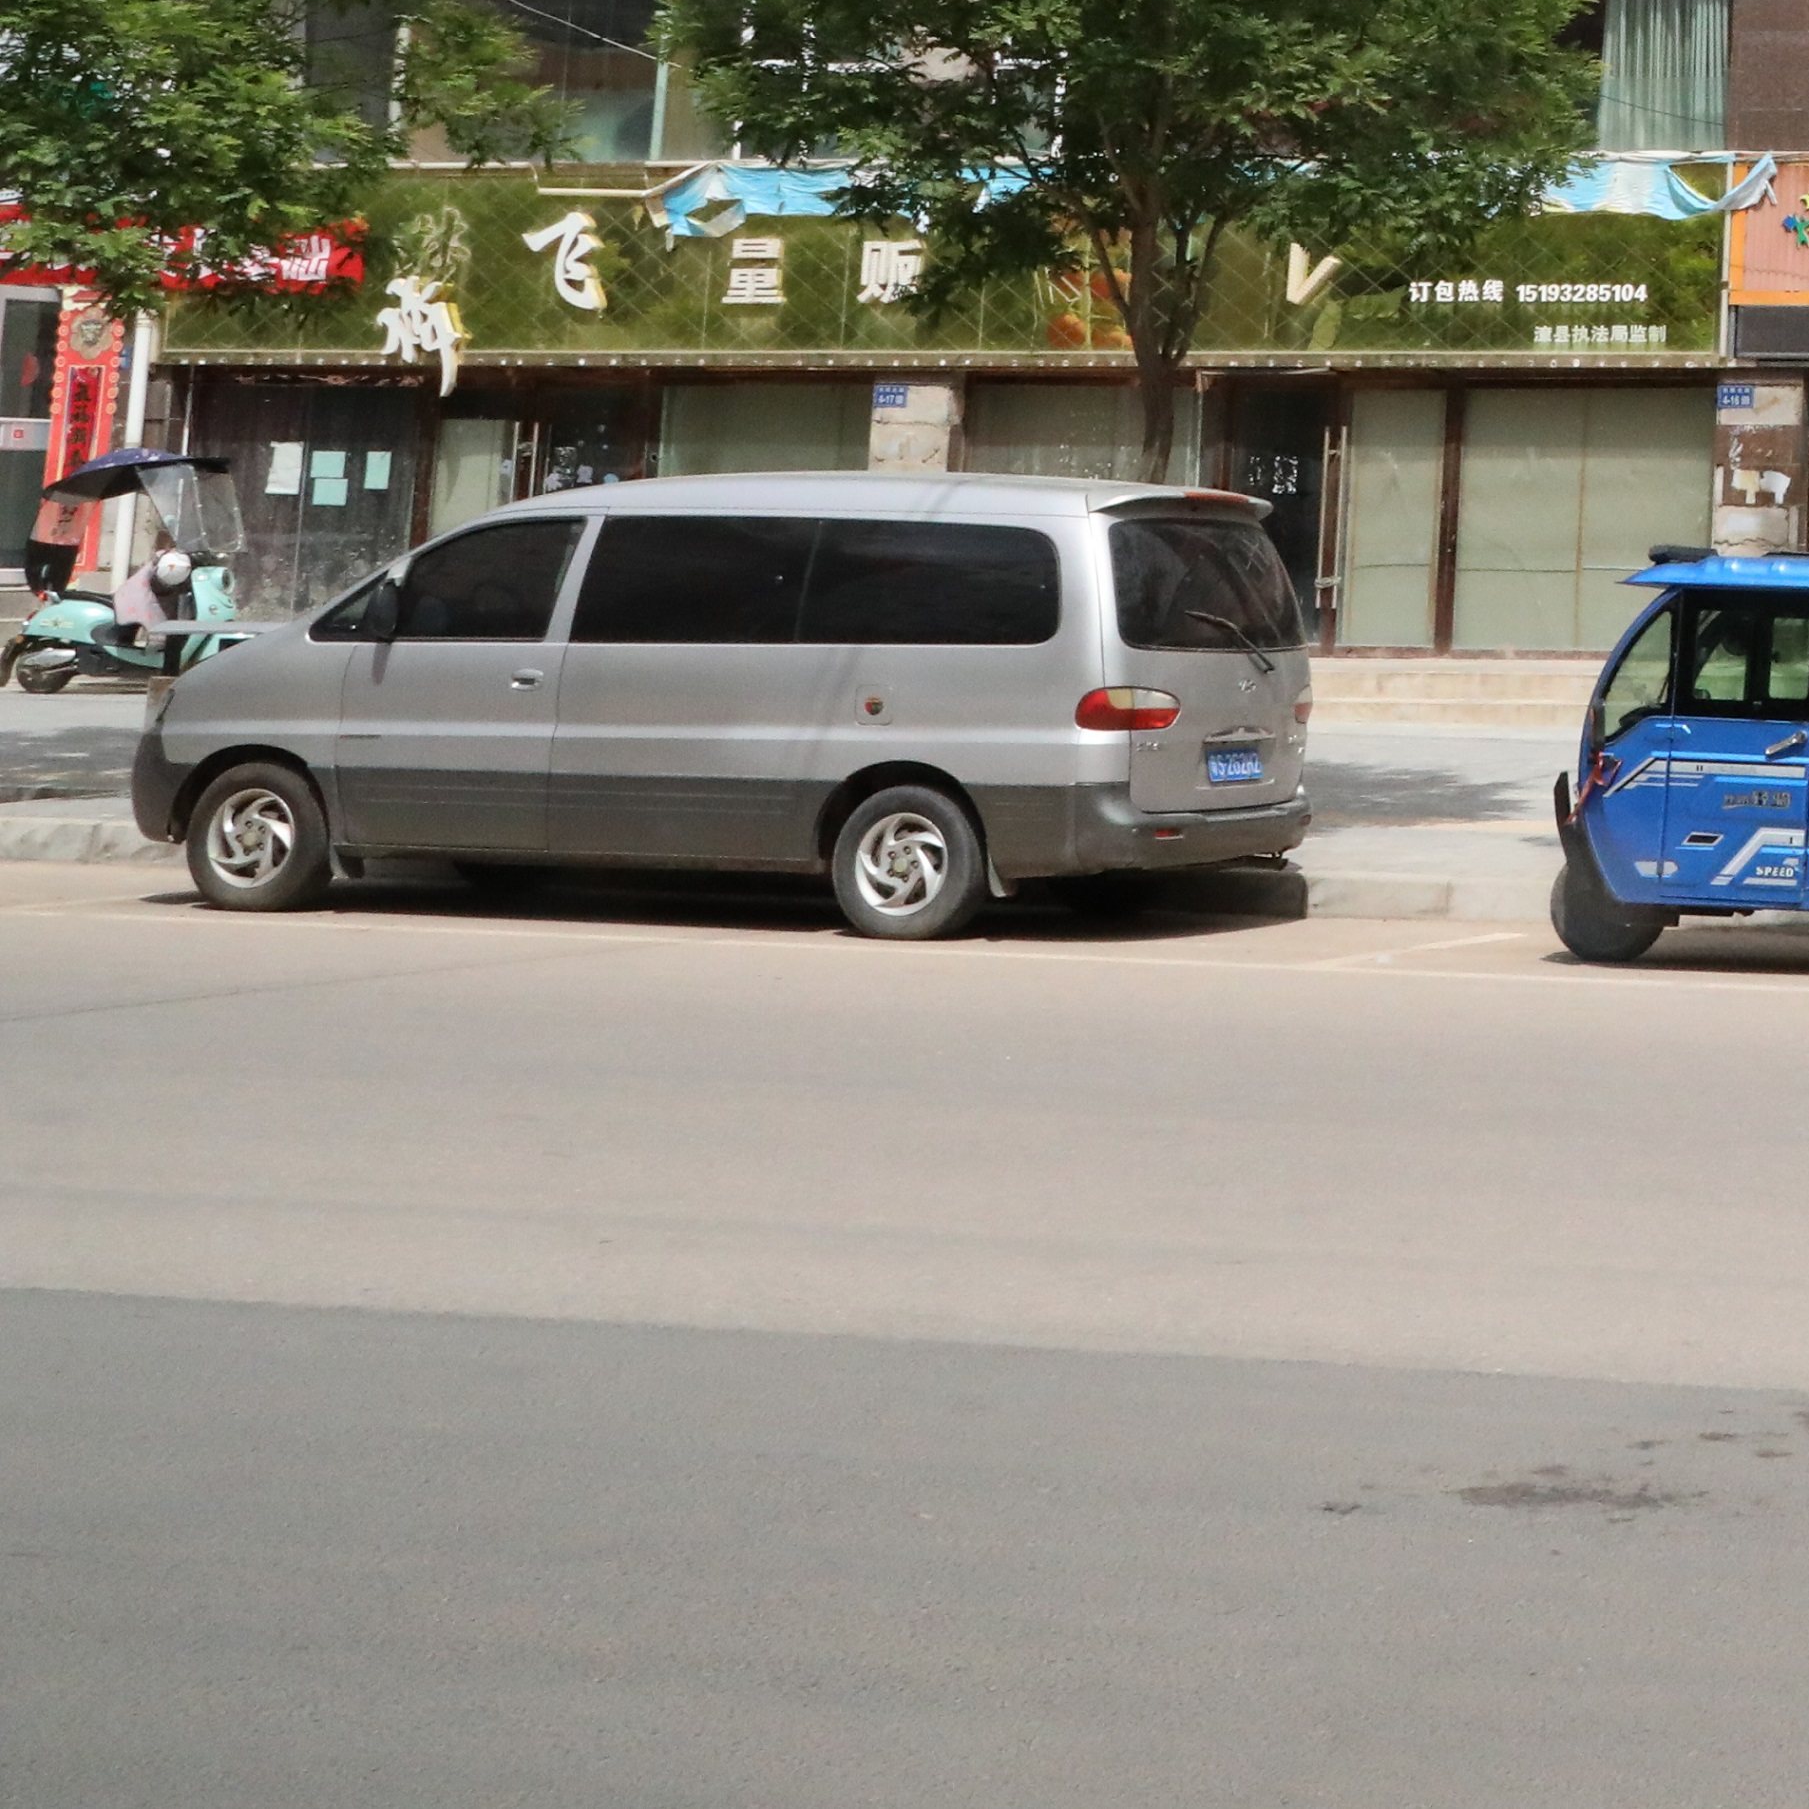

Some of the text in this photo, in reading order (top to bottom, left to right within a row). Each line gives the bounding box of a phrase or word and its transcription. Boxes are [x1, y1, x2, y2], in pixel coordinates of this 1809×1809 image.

[1408, 279, 1648, 303] 订包热线 15193285104
[1755, 865, 1794, 878] SPEED
